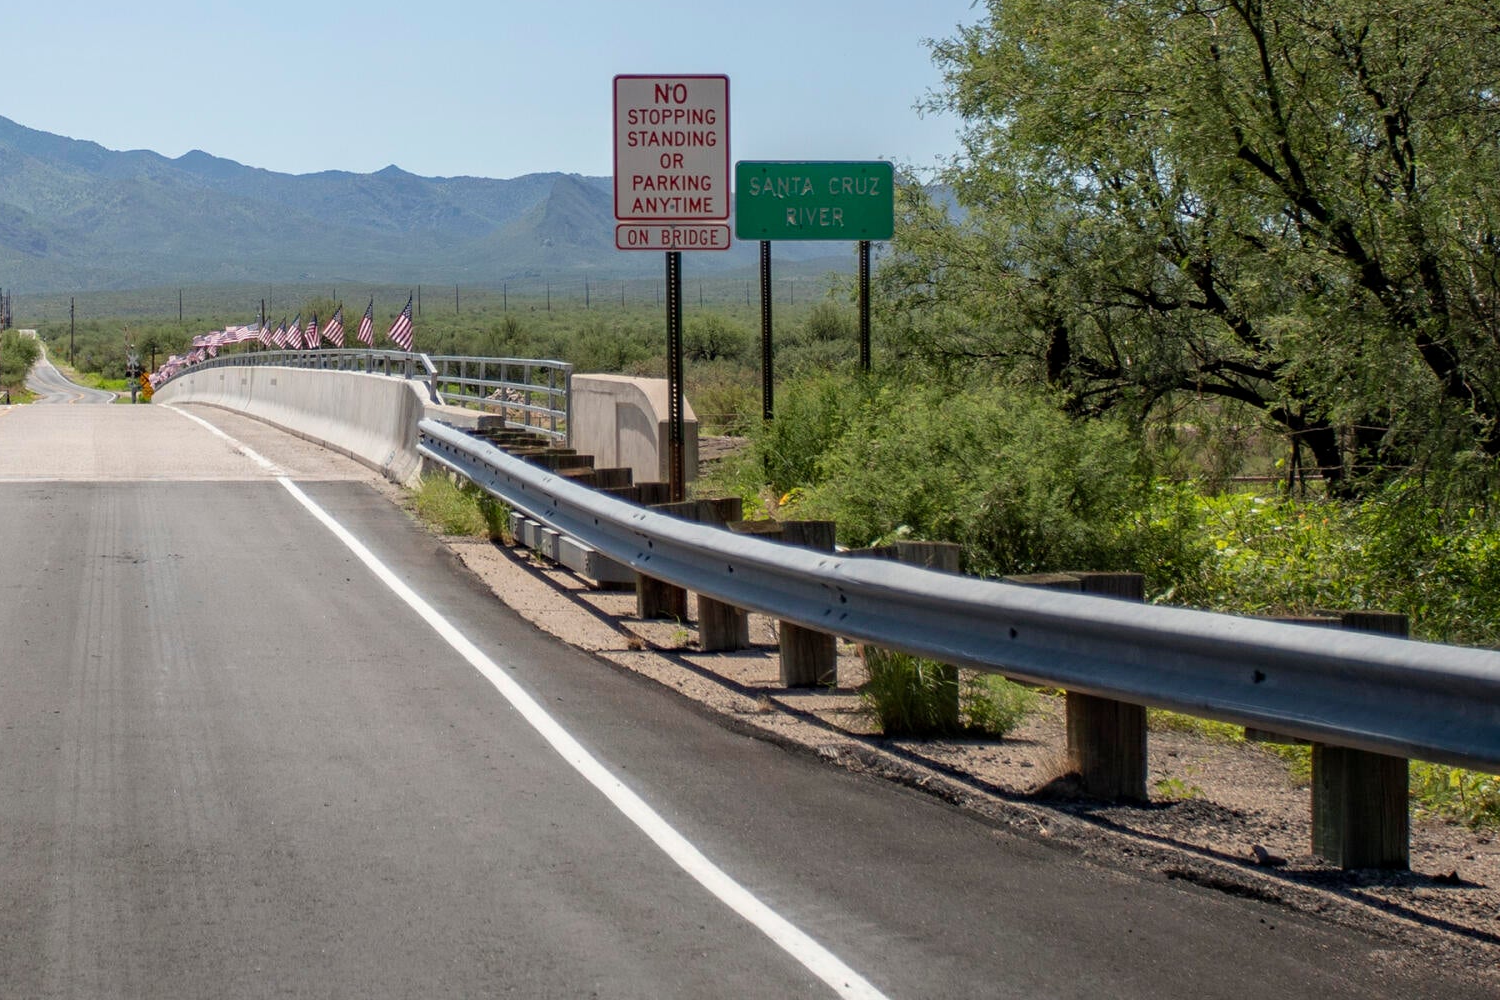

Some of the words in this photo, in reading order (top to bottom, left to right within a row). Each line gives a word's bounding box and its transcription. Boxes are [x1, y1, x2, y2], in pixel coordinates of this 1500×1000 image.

[654, 83, 687, 104] NO
[628, 109, 716, 125] STOPPING
[628, 131, 716, 147] STANDING
[660, 153, 683, 169] OR
[633, 175, 711, 191] PARKING
[749, 177, 814, 198] SANTA
[828, 177, 881, 195] CRUZ
[632, 197, 713, 213] ANYTIME
[786, 207, 844, 227] RIVER
[628, 230, 649, 245] ON
[661, 230, 718, 245] BRIDGE
